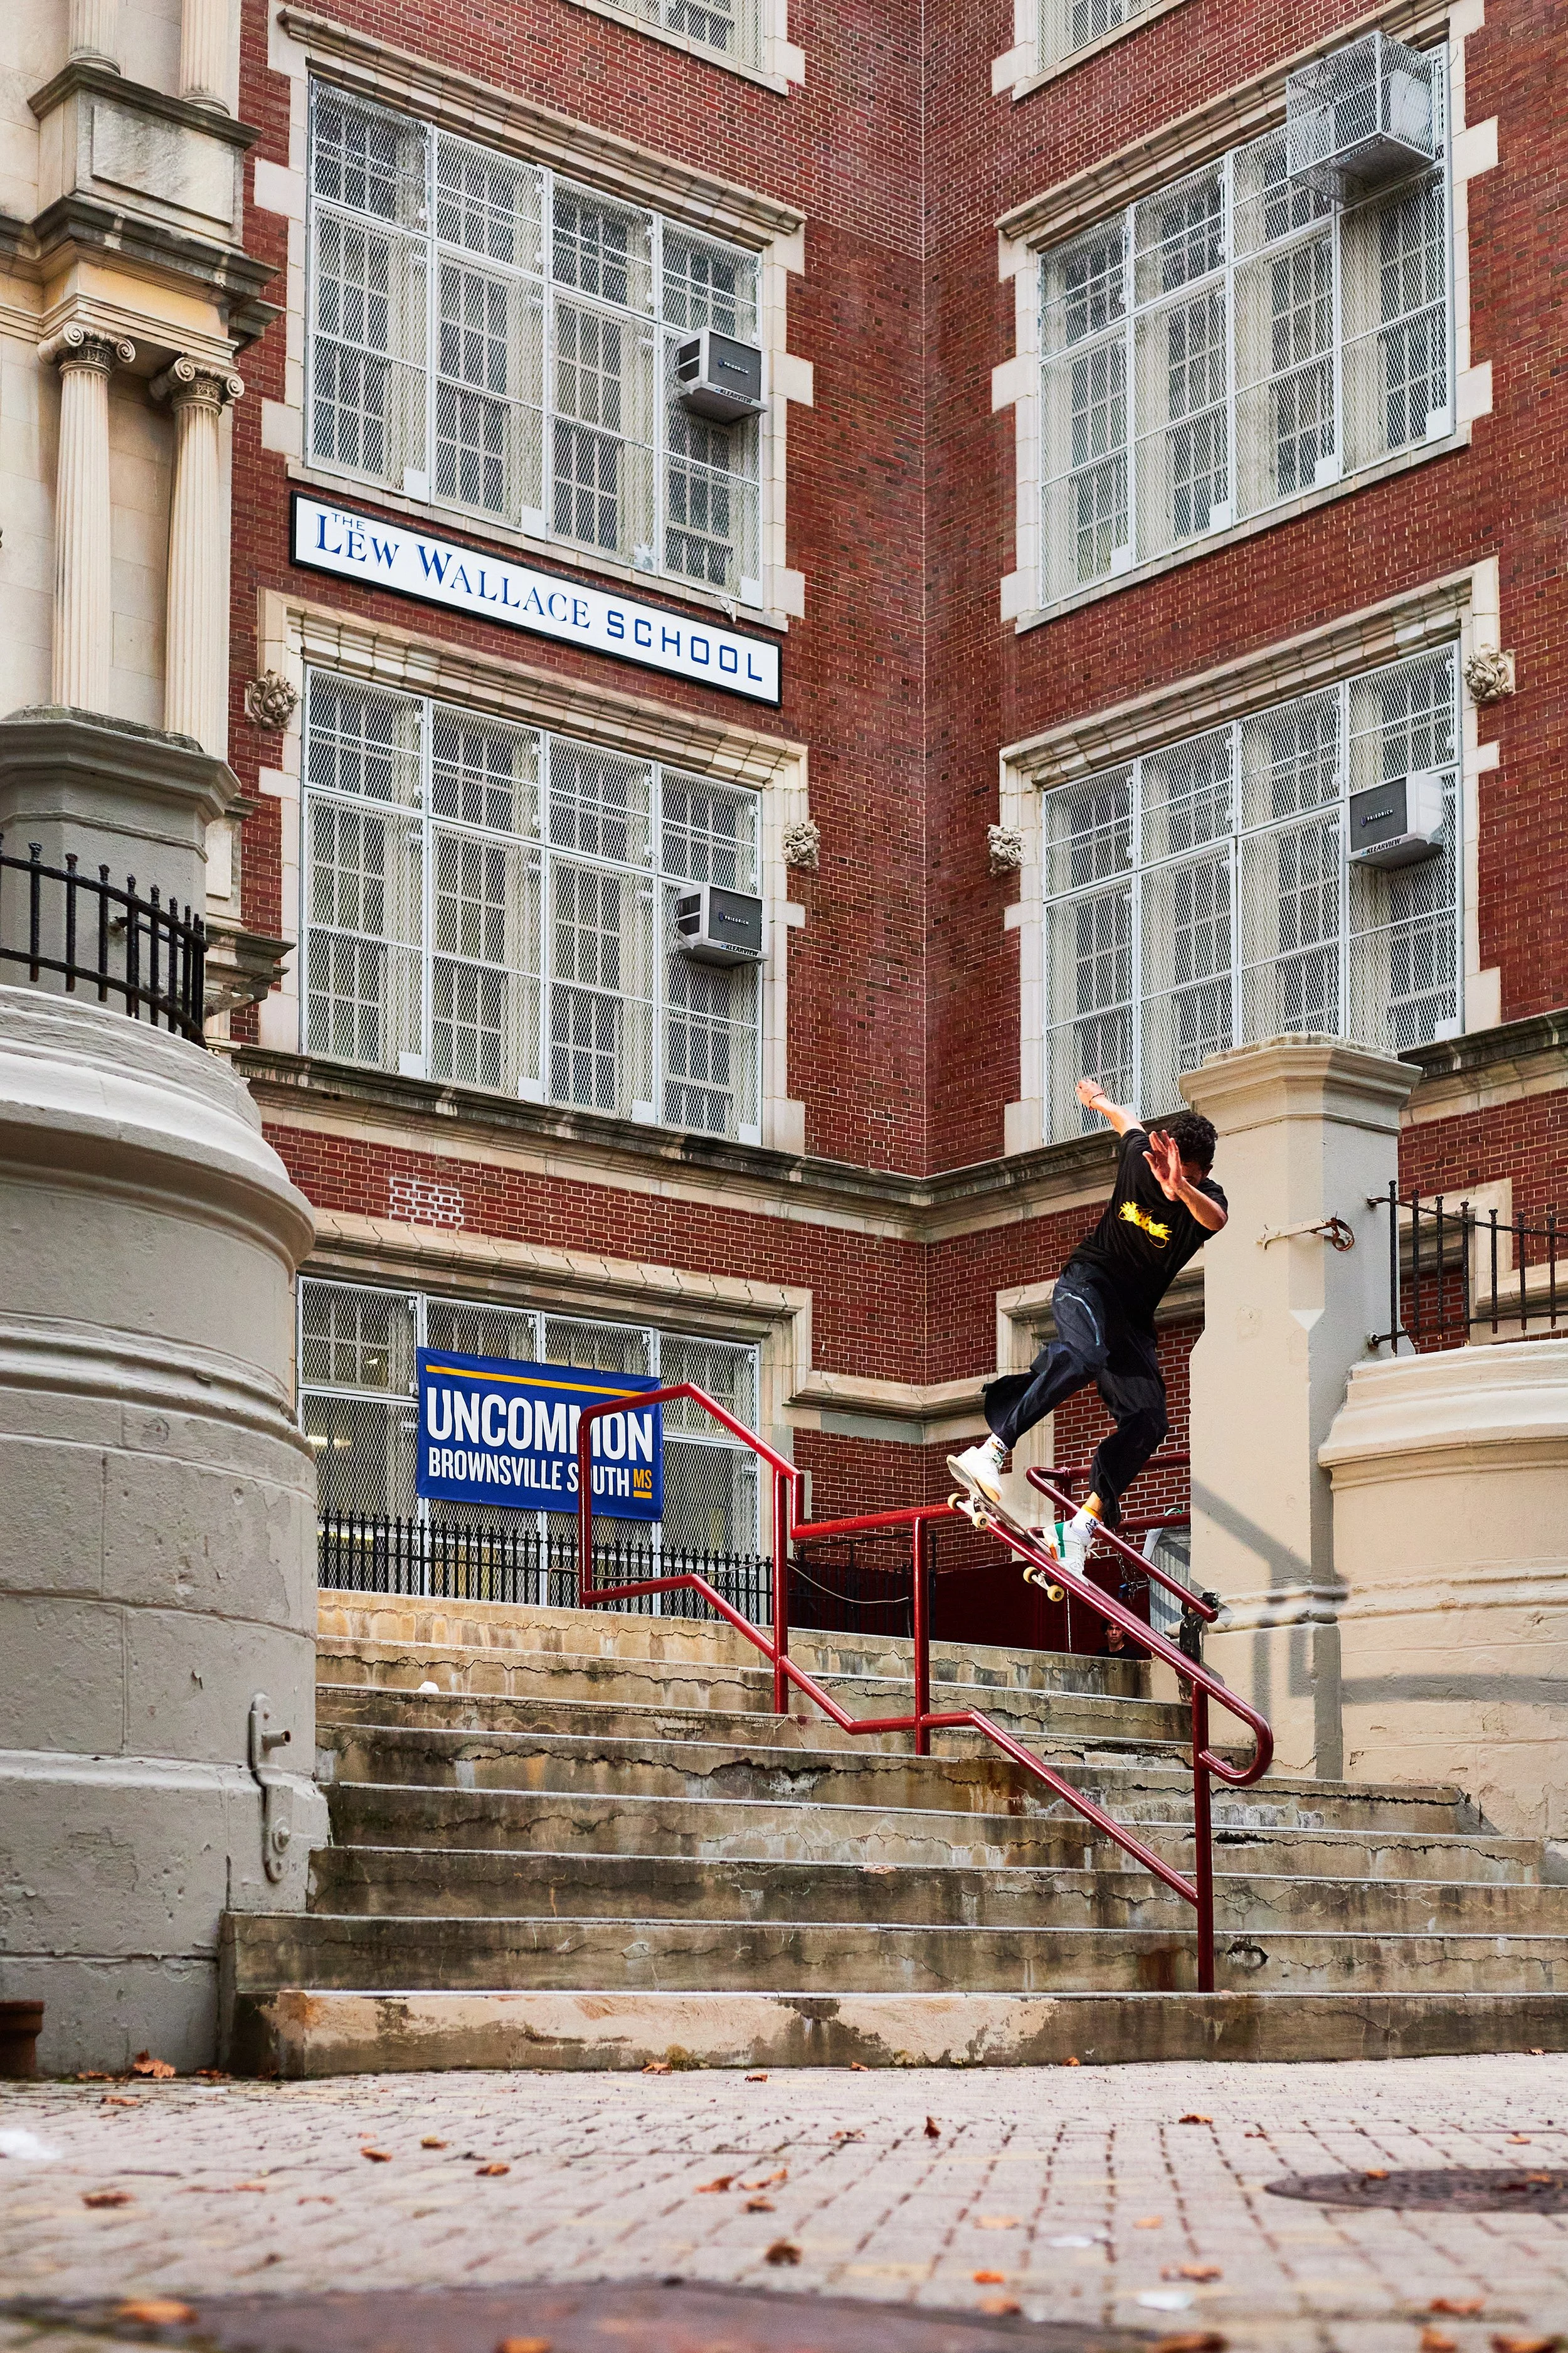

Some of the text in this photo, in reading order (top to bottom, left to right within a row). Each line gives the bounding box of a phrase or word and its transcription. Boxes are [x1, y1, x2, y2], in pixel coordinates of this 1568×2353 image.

[331, 513, 366, 531] THE
[314, 513, 763, 682] LEW WALLACE SCHOOL
[1367, 809, 1393, 821] FRIEDRICH
[1366, 837, 1401, 854] KLEARVIEW
[724, 915, 749, 925] FRIEDRICH
[725, 945, 758, 957] KLEARVIEW
[427, 1387, 653, 1462] UNCOMMON
[429, 1447, 652, 1497] BROWNSVILLE SUTH MS
